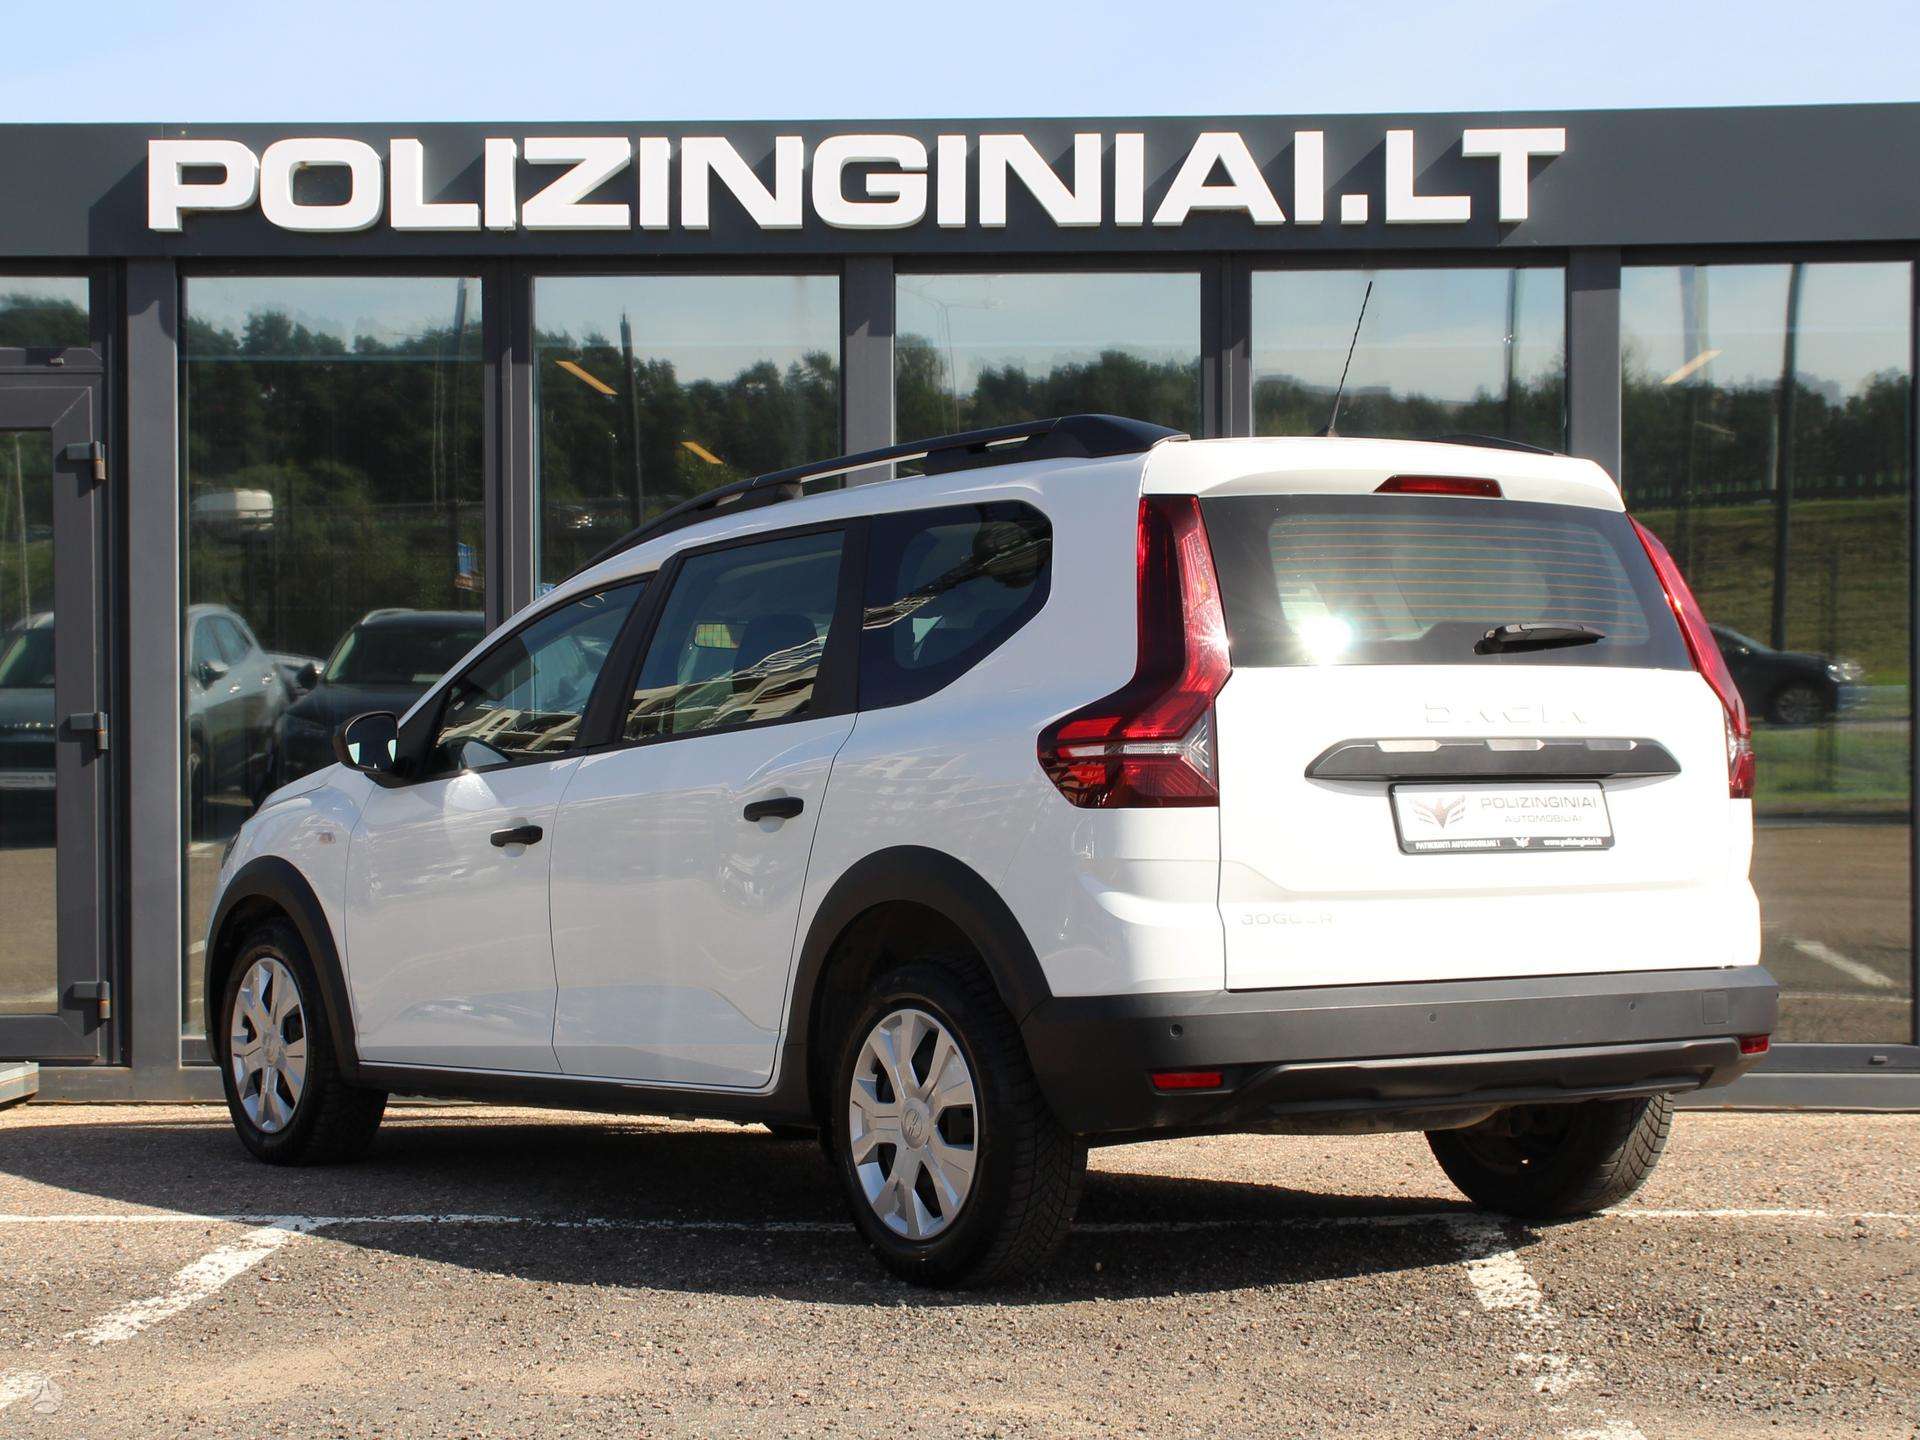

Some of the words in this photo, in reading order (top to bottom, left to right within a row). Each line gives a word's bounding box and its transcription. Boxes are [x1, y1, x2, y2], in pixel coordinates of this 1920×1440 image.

[148, 128, 1566, 232] POLIZINGINIAI.LT
[1480, 796, 1597, 809] POLIZINGINIAI
[1240, 911, 1331, 925] JOGR
